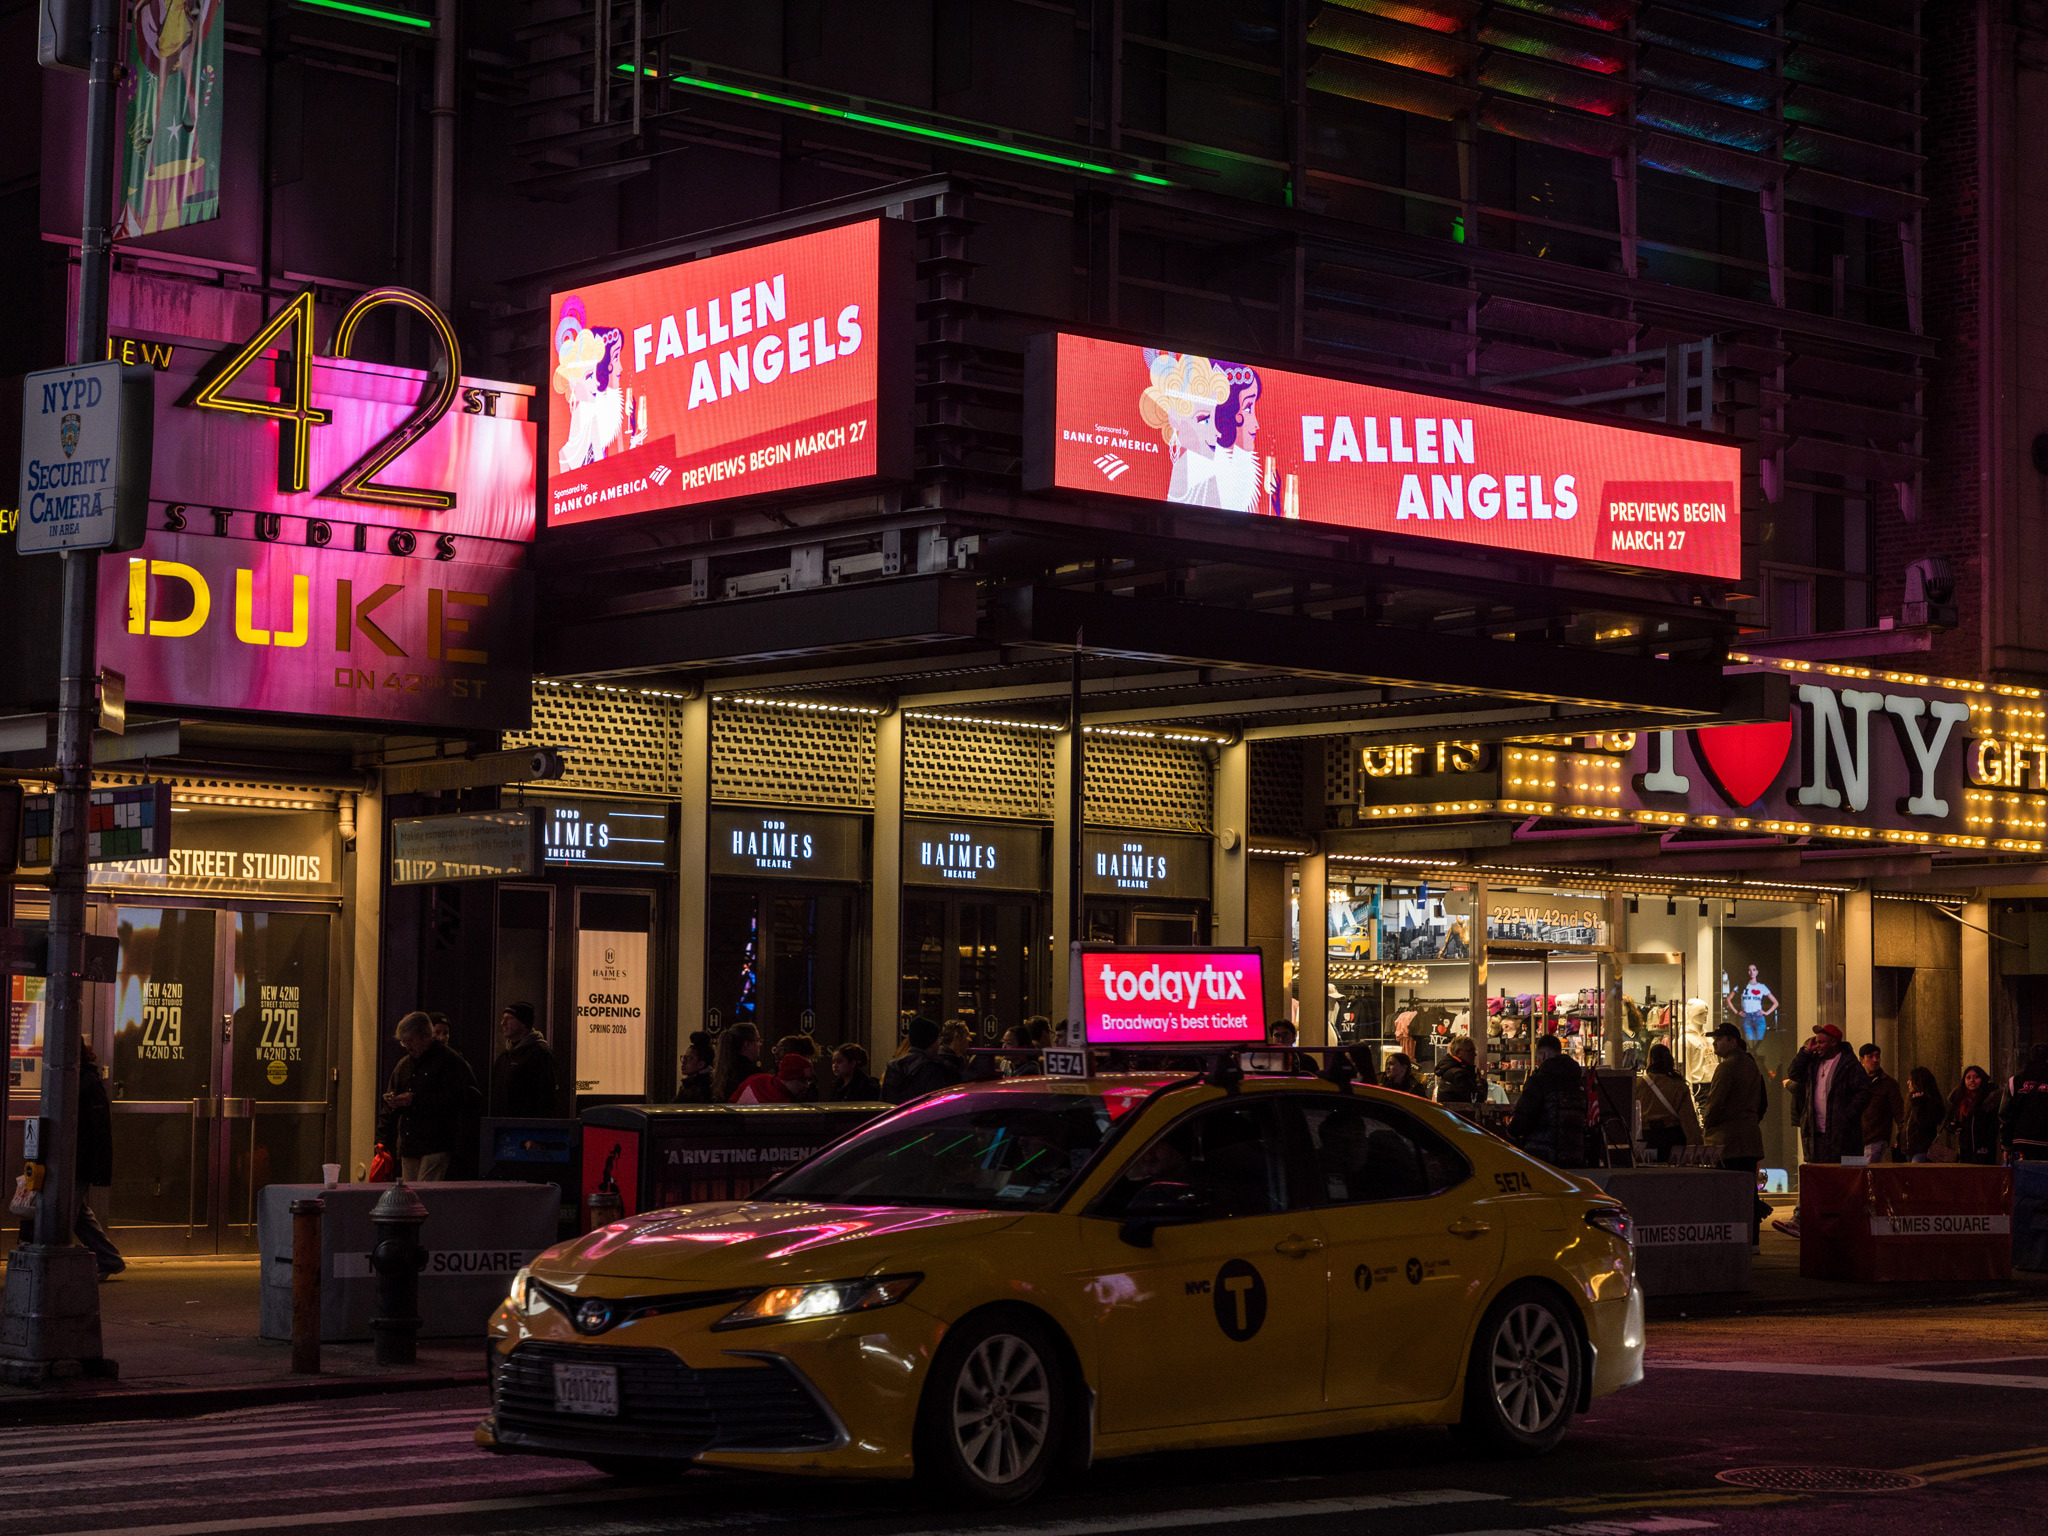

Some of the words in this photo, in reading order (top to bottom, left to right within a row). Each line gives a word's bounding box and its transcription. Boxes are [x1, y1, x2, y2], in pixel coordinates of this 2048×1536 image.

[633, 273, 786, 373] FALLEN
[687, 304, 863, 411] ANGELS
[42, 377, 102, 414] NYPD
[108, 337, 173, 368] EW
[175, 281, 461, 510] 42
[463, 388, 500, 416] ST
[1094, 423, 1122, 434] Sponsored
[1123, 427, 1129, 437] by
[1301, 415, 1475, 464] FALLEN
[1063, 430, 1093, 444] BANK
[1095, 435, 1109, 445] OF
[1111, 438, 1159, 453] AMERICA
[682, 455, 746, 491] PREVIEWS
[749, 442, 790, 472] BEGIN
[794, 429, 845, 459] MARCH
[849, 420, 868, 443] 27
[27, 457, 110, 491] SECURITY
[554, 484, 580, 499] Sponsored
[554, 495, 583, 515] BANK
[584, 492, 598, 506] OF
[599, 478, 648, 502] AMERICA
[1396, 473, 1579, 520] ANGELS
[30, 492, 103, 524] CAMERA
[1610, 502, 1680, 523] PREVIEWS
[1683, 503, 1726, 523] BEGIN
[49, 524, 58, 537] IN
[59, 523, 80, 536] AREA
[165, 504, 456, 561] STUDIOS
[1611, 531, 1664, 551] MARCH
[1668, 531, 1686, 551] 27
[128, 557, 489, 665] DUKE
[335, 668, 374, 690] ON
[453, 678, 488, 700] ST
[1798, 684, 1970, 818] NY
[555, 808, 580, 819] TODD
[763, 820, 786, 830] TODD
[732, 830, 813, 859] HAIMES
[949, 832, 971, 842] TODD
[547, 848, 586, 859] THEATRE
[921, 842, 996, 869] HAIMES
[1123, 843, 1142, 853] TODD
[169, 849, 237, 877] STREET
[242, 852, 321, 881] STUDIOS
[756, 858, 792, 869] THEATRE
[1097, 853, 1166, 879] HAIMES
[943, 869, 977, 879] THEATRE
[1117, 878, 1148, 889] THEATRE
[1493, 906, 1520, 925] 225
[1524, 907, 1539, 925] W
[1542, 908, 1579, 928] 42nd
[1583, 911, 1603, 930] St.
[592, 969, 627, 977] HAIMES
[143, 983, 160, 998] NEW
[162, 983, 183, 998] 42ND
[261, 985, 277, 1001] NEW
[279, 986, 299, 1001] 42ND
[1100, 964, 1246, 1009] todaytix
[143, 998, 161, 1006] STREET
[161, 998, 183, 1006] STUDIOS
[260, 1000, 278, 1008] STREET
[278, 1000, 299, 1008] STUDIOS
[589, 993, 630, 1004] GRAND
[577, 1006, 641, 1018] REOPENING
[1102, 1012, 1178, 1032] Broadway's
[1180, 1013, 1209, 1029] best
[1211, 1013, 1248, 1029] ticket
[142, 1006, 182, 1046] 229
[260, 1008, 299, 1048] 229
[589, 1024, 611, 1034] SPRING
[612, 1024, 627, 1034] 2026
[1429, 1035, 1448, 1045] NY
[137, 1046, 144, 1059] W
[145, 1046, 170, 1060] 42ND
[172, 1046, 184, 1060] ST.
[256, 1047, 263, 1060] W
[263, 1047, 287, 1061] 42ND
[289, 1047, 302, 1061] ST.
[1048, 1052, 1082, 1075] 5E74
[682, 1148, 757, 1164] RIVETING
[1494, 1172, 1532, 1192] 5E74
[1637, 1226, 1676, 1243] TIMES
[1678, 1225, 1732, 1242] SQUARE
[1889, 1217, 1930, 1233] TIMES
[1934, 1217, 1990, 1232] SQUARE
[433, 1252, 522, 1273] SQUARE
[1185, 1280, 1211, 1296] NYC
